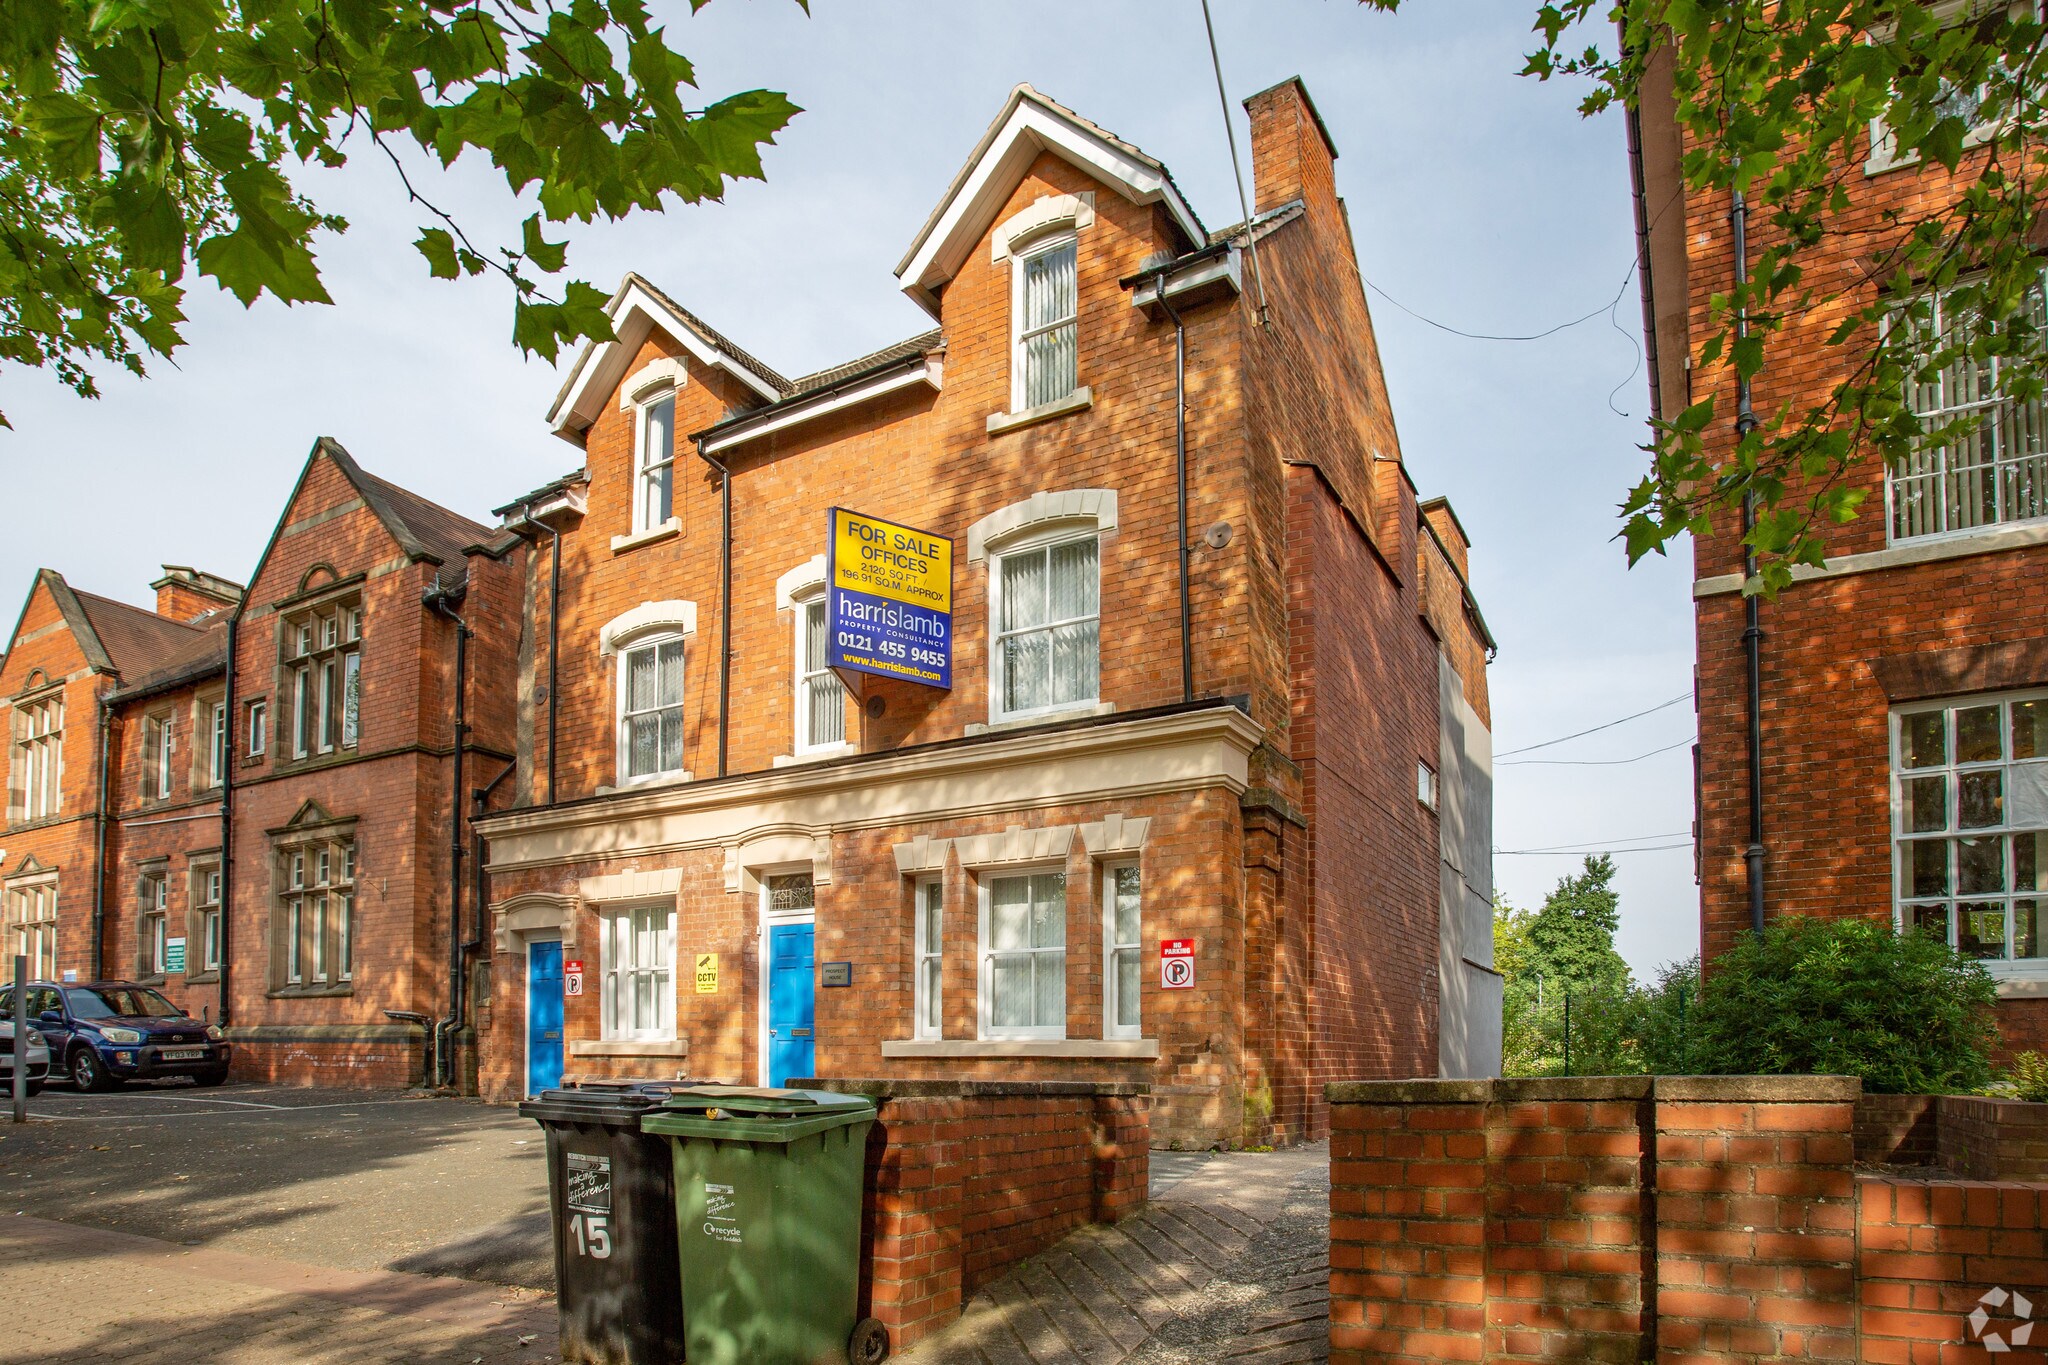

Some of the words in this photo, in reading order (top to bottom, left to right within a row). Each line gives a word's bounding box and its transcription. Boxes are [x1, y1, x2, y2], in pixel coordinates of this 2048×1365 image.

[848, 521, 886, 545] FOR
[893, 533, 940, 560] SALE
[861, 545, 928, 574] OFFICES
[841, 568, 872, 583] 196.91
[906, 584, 944, 602] APPROX
[840, 592, 945, 638] harrislamb
[839, 619, 882, 633] PROPERTY
[886, 629, 945, 648] CONSULTANCY
[838, 631, 873, 652] 0121
[878, 640, 906, 659] 455
[911, 647, 946, 668] 9455
[842, 653, 942, 682] www.harrislamb.com
[697, 972, 717, 982] CCTV
[568, 1170, 598, 1186] making
[580, 1182, 585, 1190] a
[568, 1182, 610, 1204] difference
[706, 1195, 726, 1205] making
[706, 1201, 736, 1215] difference
[569, 1214, 611, 1259] 15
[715, 1227, 741, 1236] recycle
